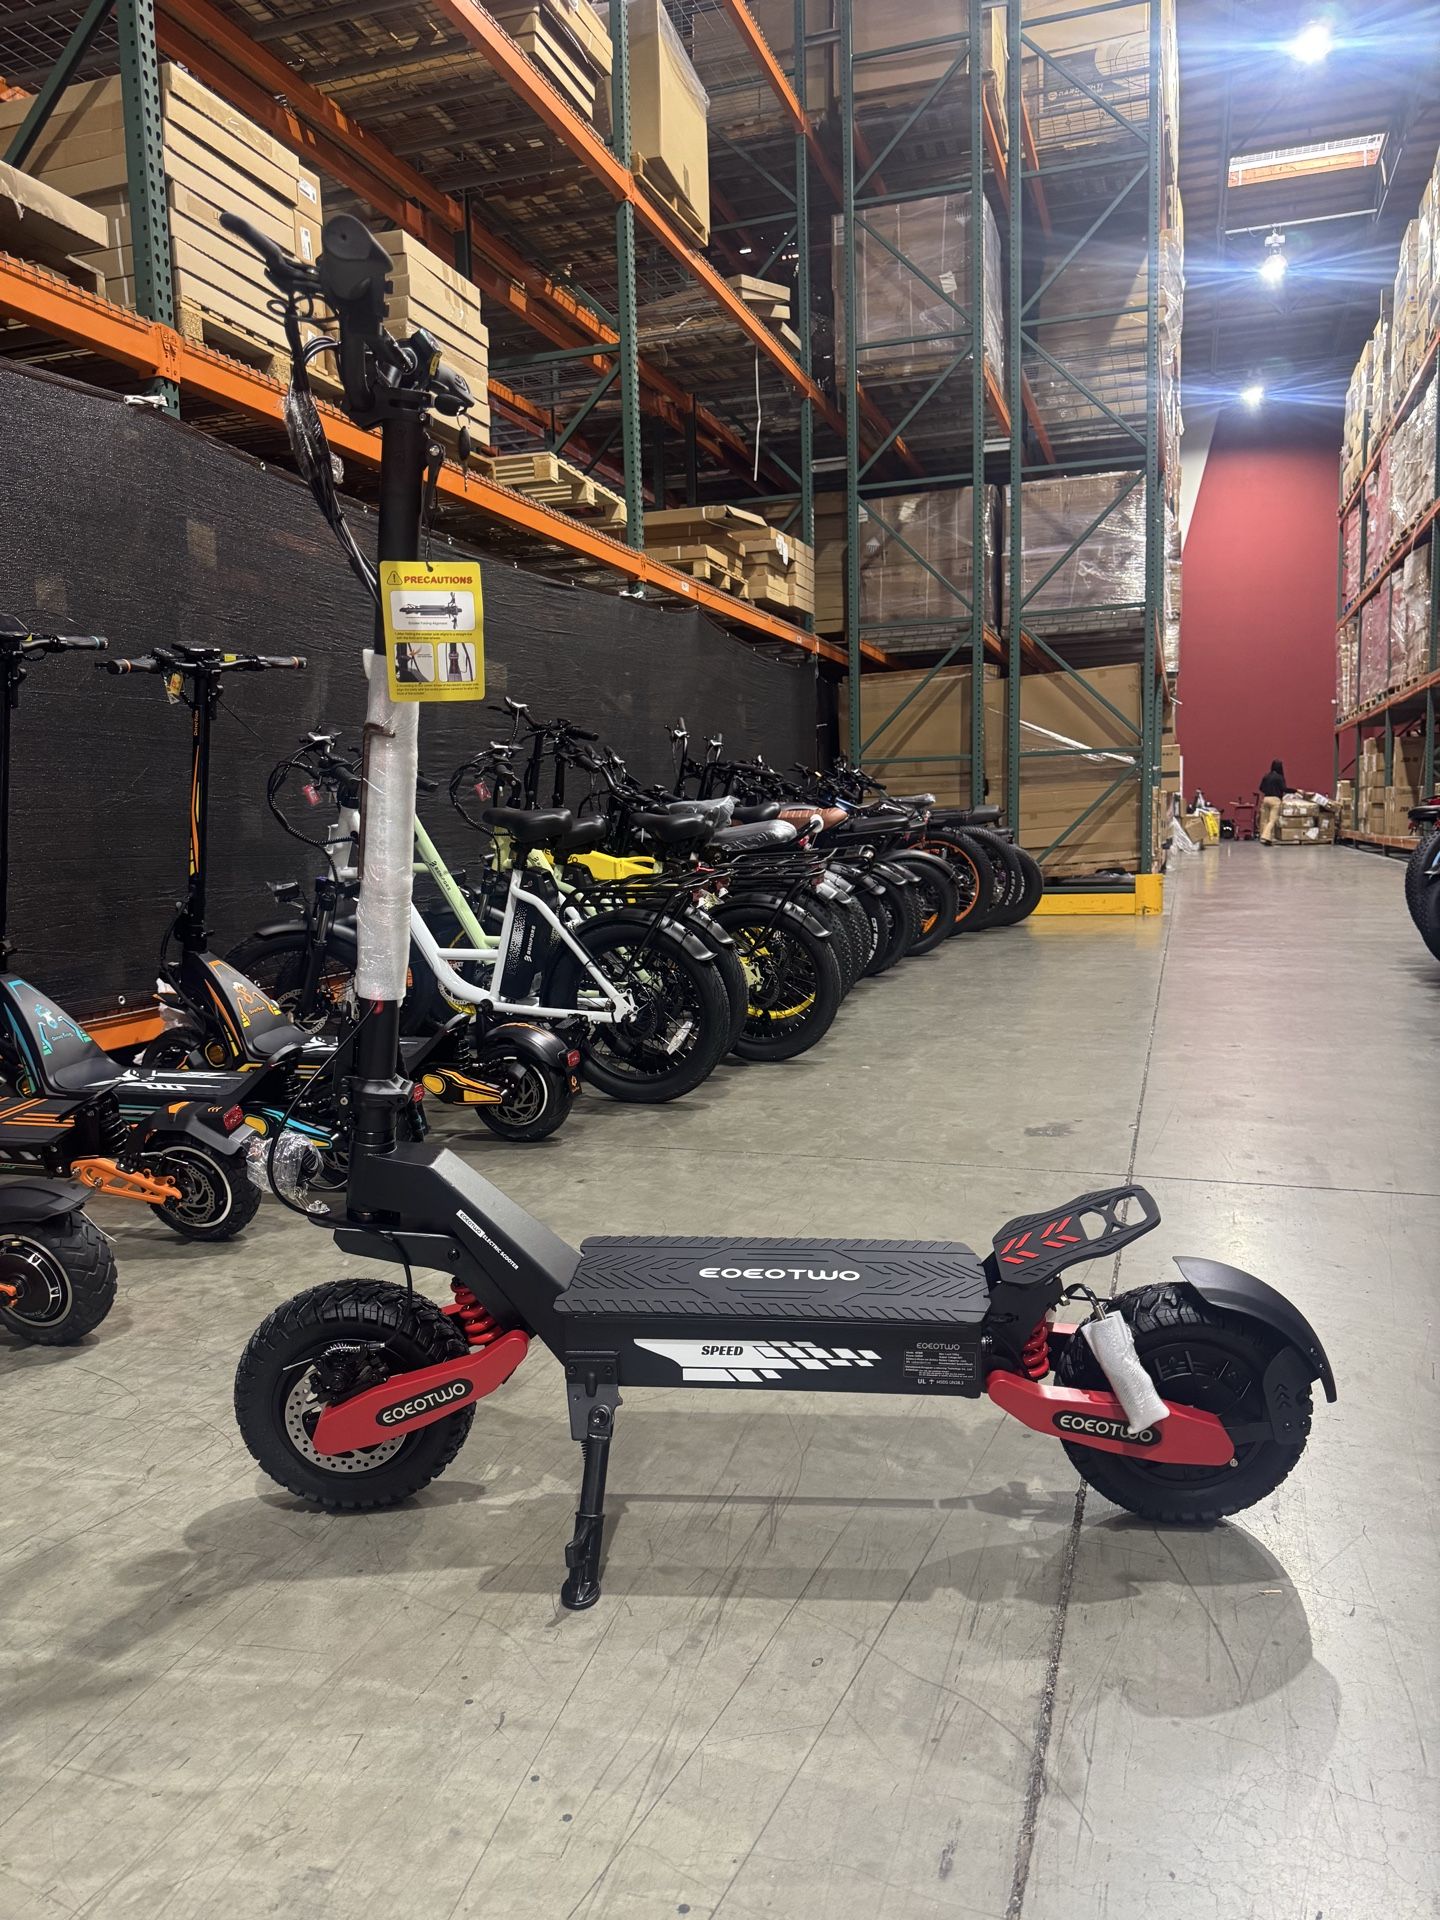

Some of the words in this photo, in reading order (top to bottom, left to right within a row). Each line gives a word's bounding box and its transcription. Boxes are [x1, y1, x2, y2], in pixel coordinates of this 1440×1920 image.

[403, 576, 473, 584] PRECAUTIONS
[482, 1234, 502, 1254] ELECTRIC
[500, 1251, 519, 1270] SCOOTER
[699, 1267, 860, 1281] EOEOTWO
[701, 1345, 744, 1356] SPEED
[916, 1342, 960, 1351] EOEOTWO
[382, 1383, 466, 1424] EOEOTWO
